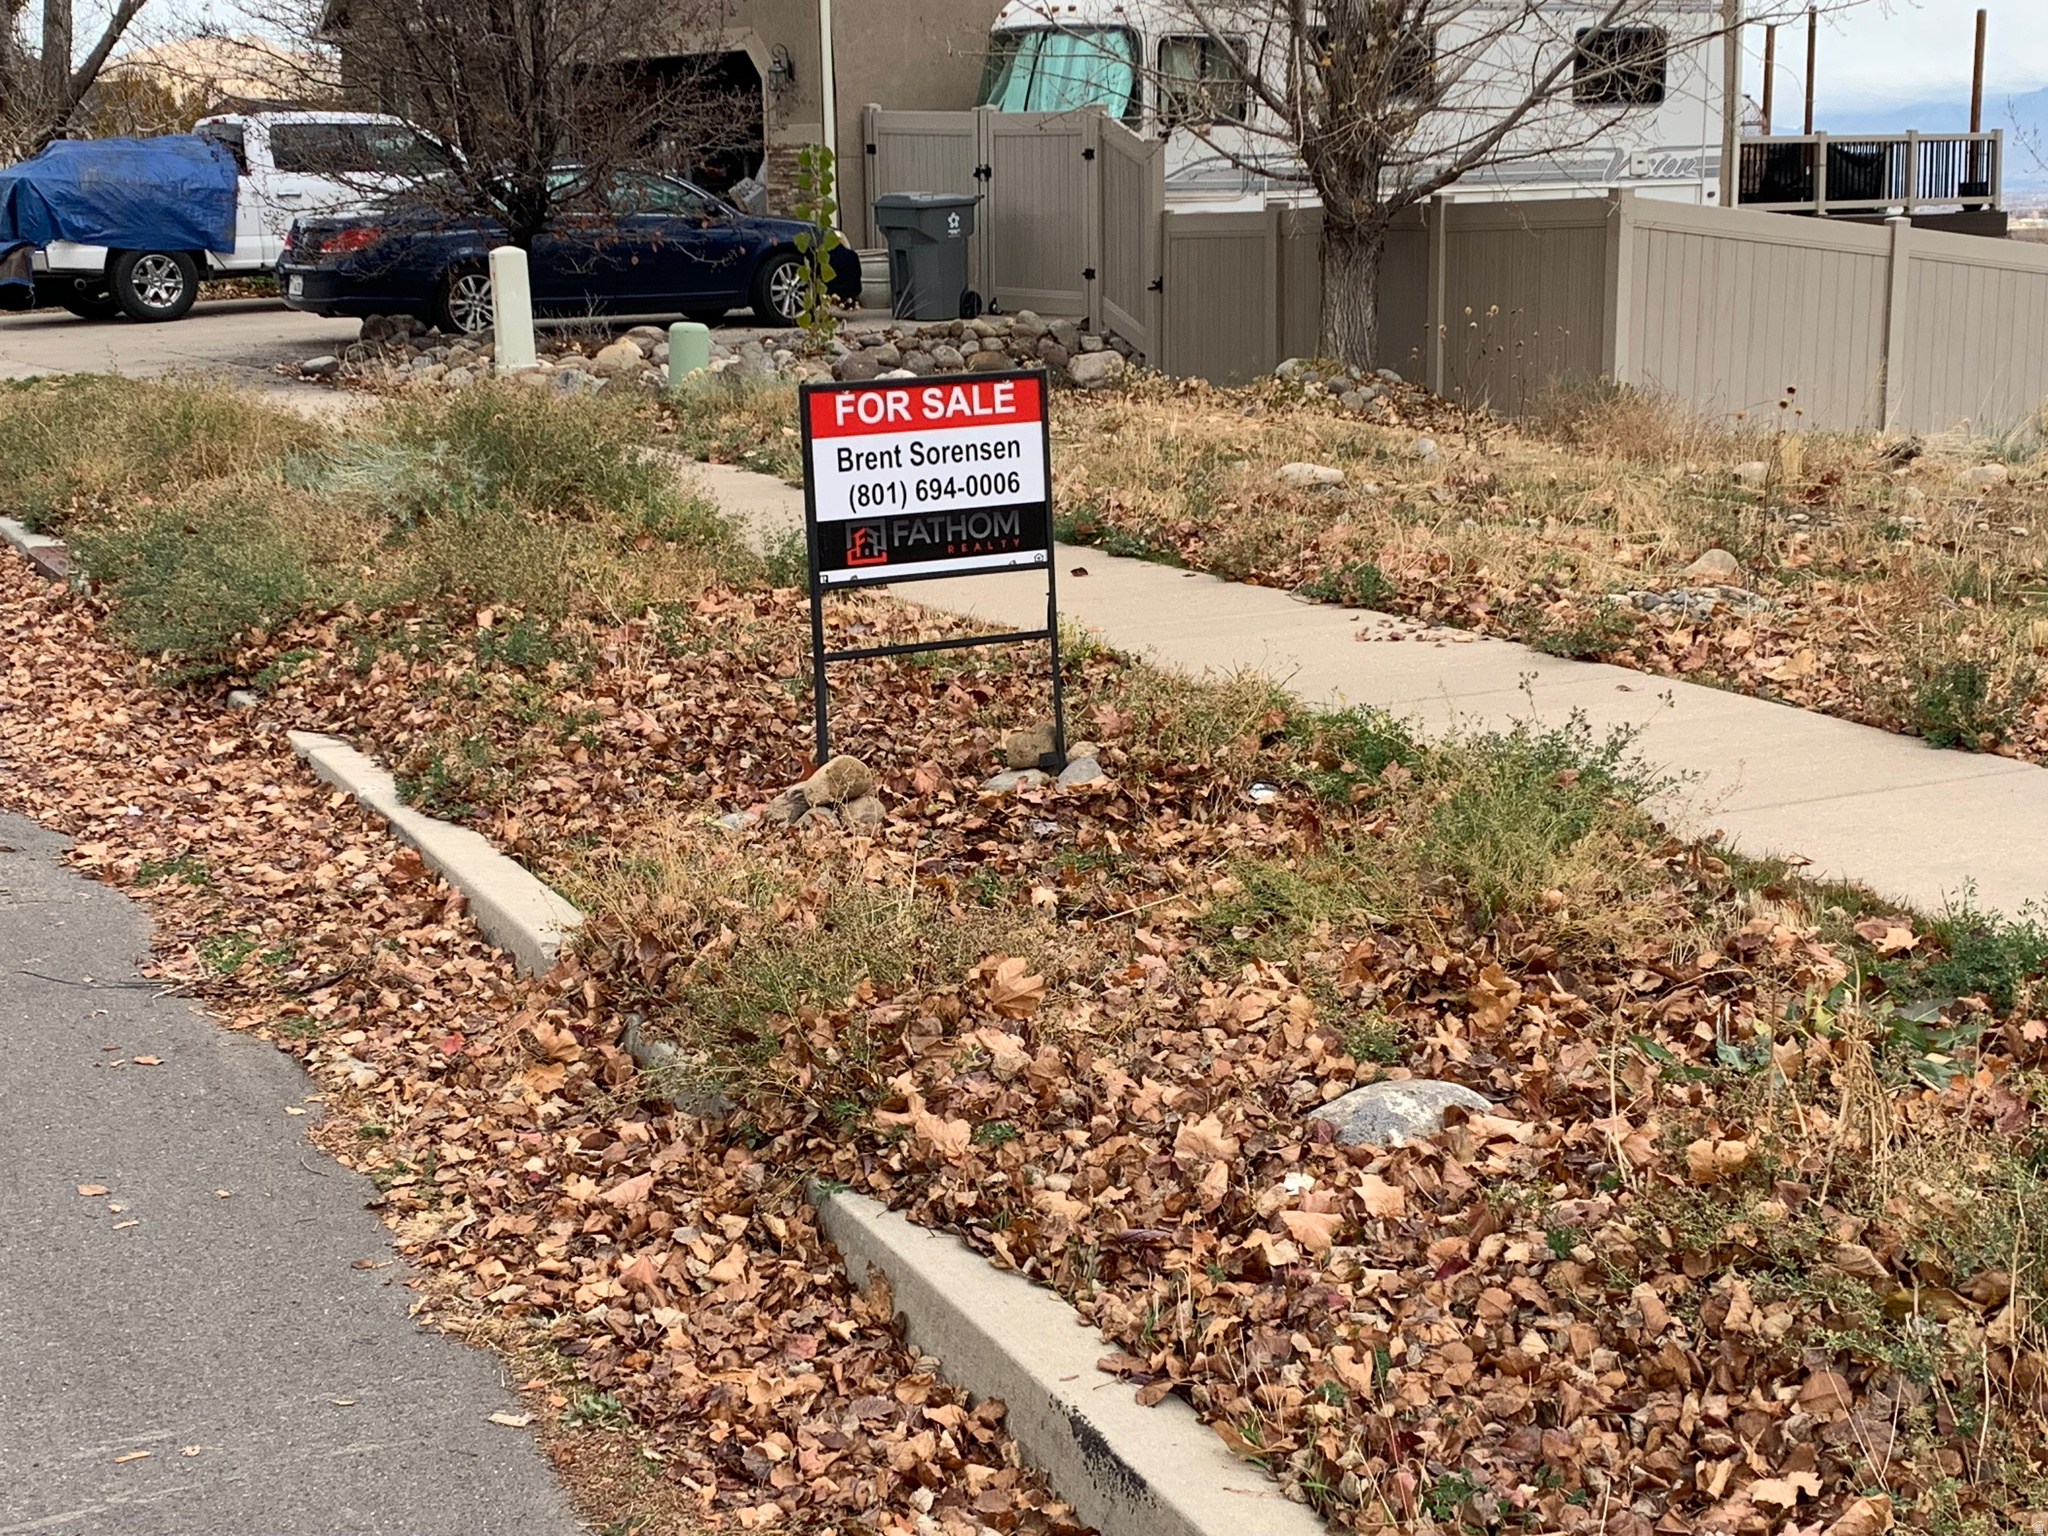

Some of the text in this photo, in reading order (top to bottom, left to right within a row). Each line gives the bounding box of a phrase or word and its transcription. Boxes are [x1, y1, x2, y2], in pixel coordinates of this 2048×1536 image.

[834, 382, 1016, 426] FOR SALE
[837, 439, 1021, 472] Brent Sorensen
[849, 471, 1020, 514] (801) 694-0006
[892, 511, 1020, 547] FATHOM
[947, 538, 1020, 554] REALTY
